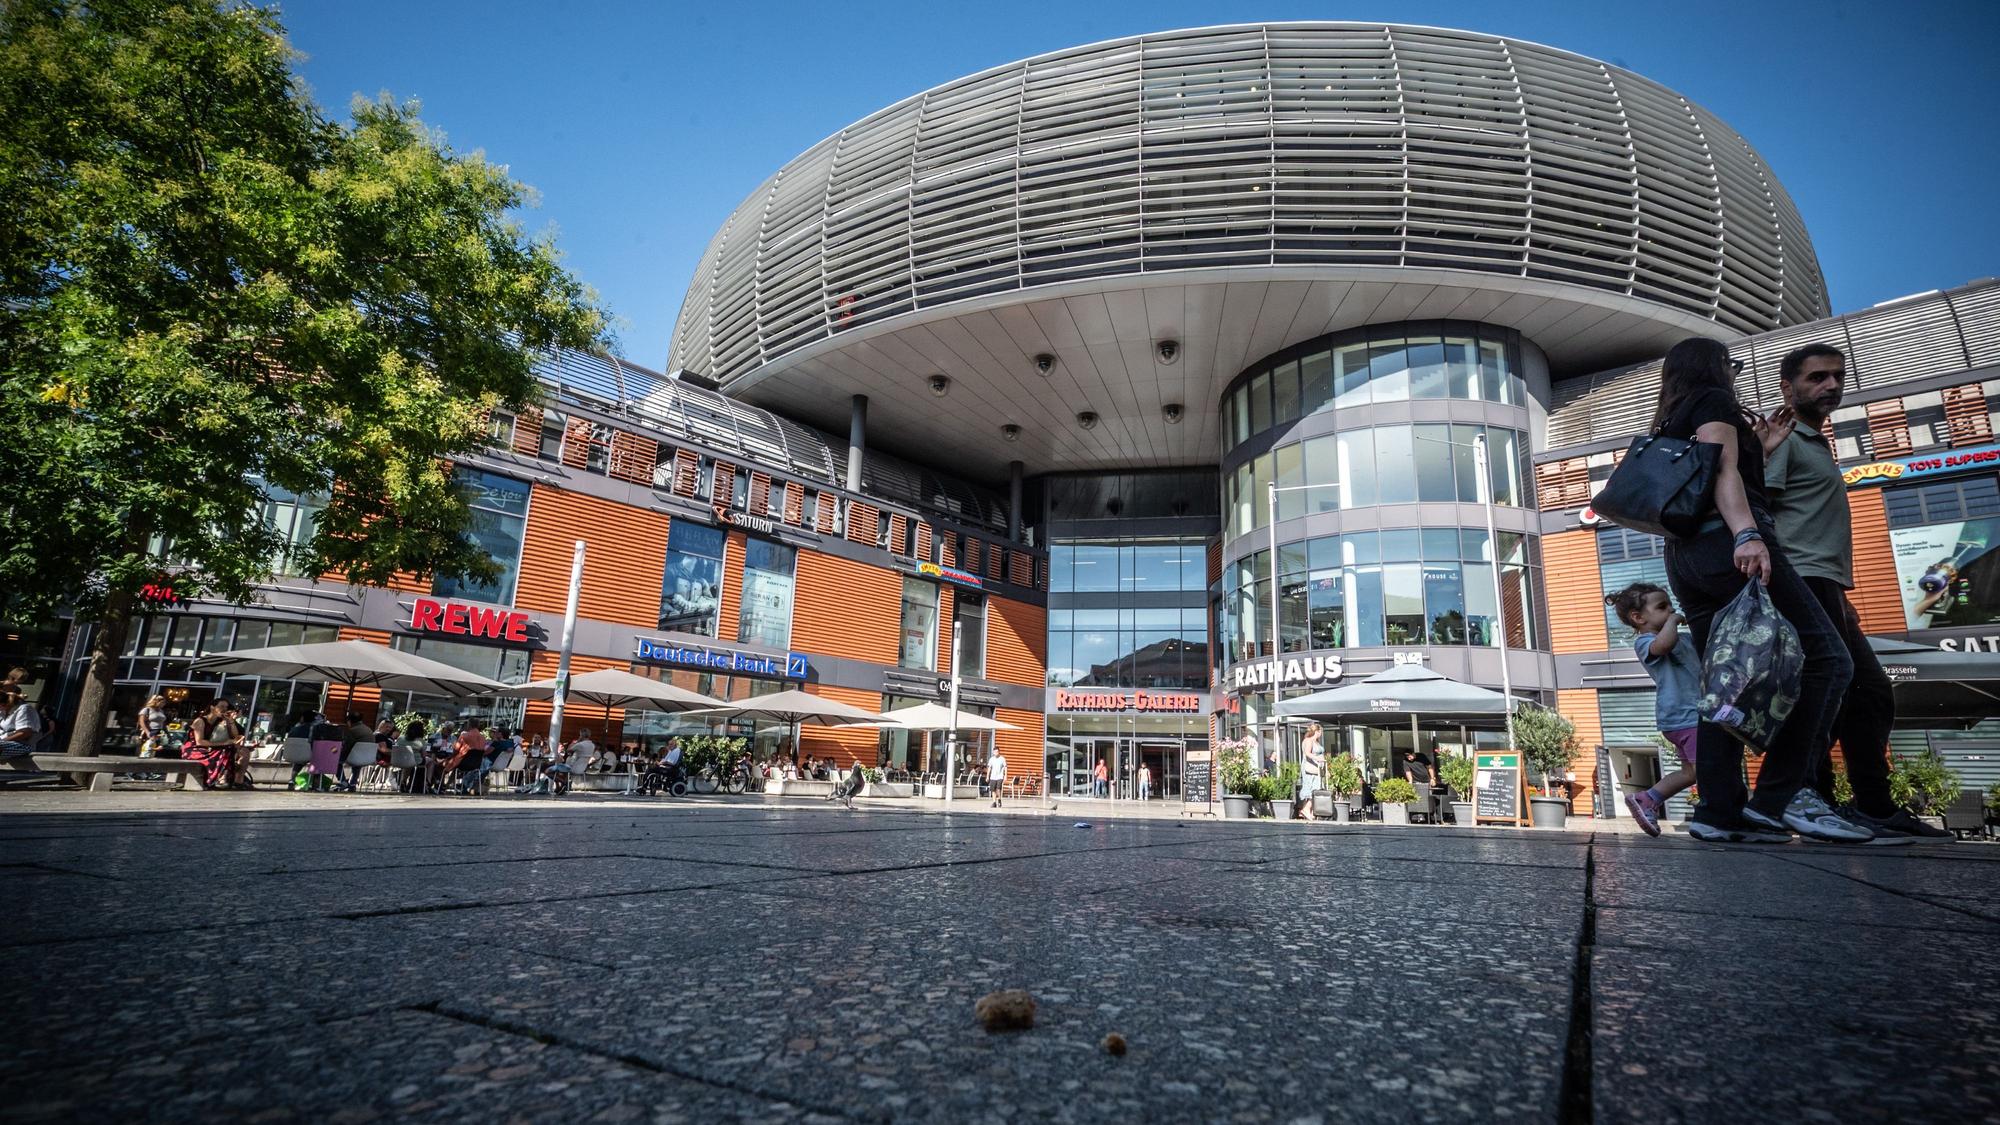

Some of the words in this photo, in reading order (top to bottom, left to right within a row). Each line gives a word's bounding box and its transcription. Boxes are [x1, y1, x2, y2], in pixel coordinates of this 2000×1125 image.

[1843, 465, 1902, 482] SMYTHS
[1908, 461, 1942, 472] TOYS
[734, 512, 773, 533] SATURN
[410, 599, 529, 641] REWE
[638, 639, 727, 668] Deutsche
[732, 651, 777, 674] Bank
[1235, 655, 1343, 688] RATHAUS
